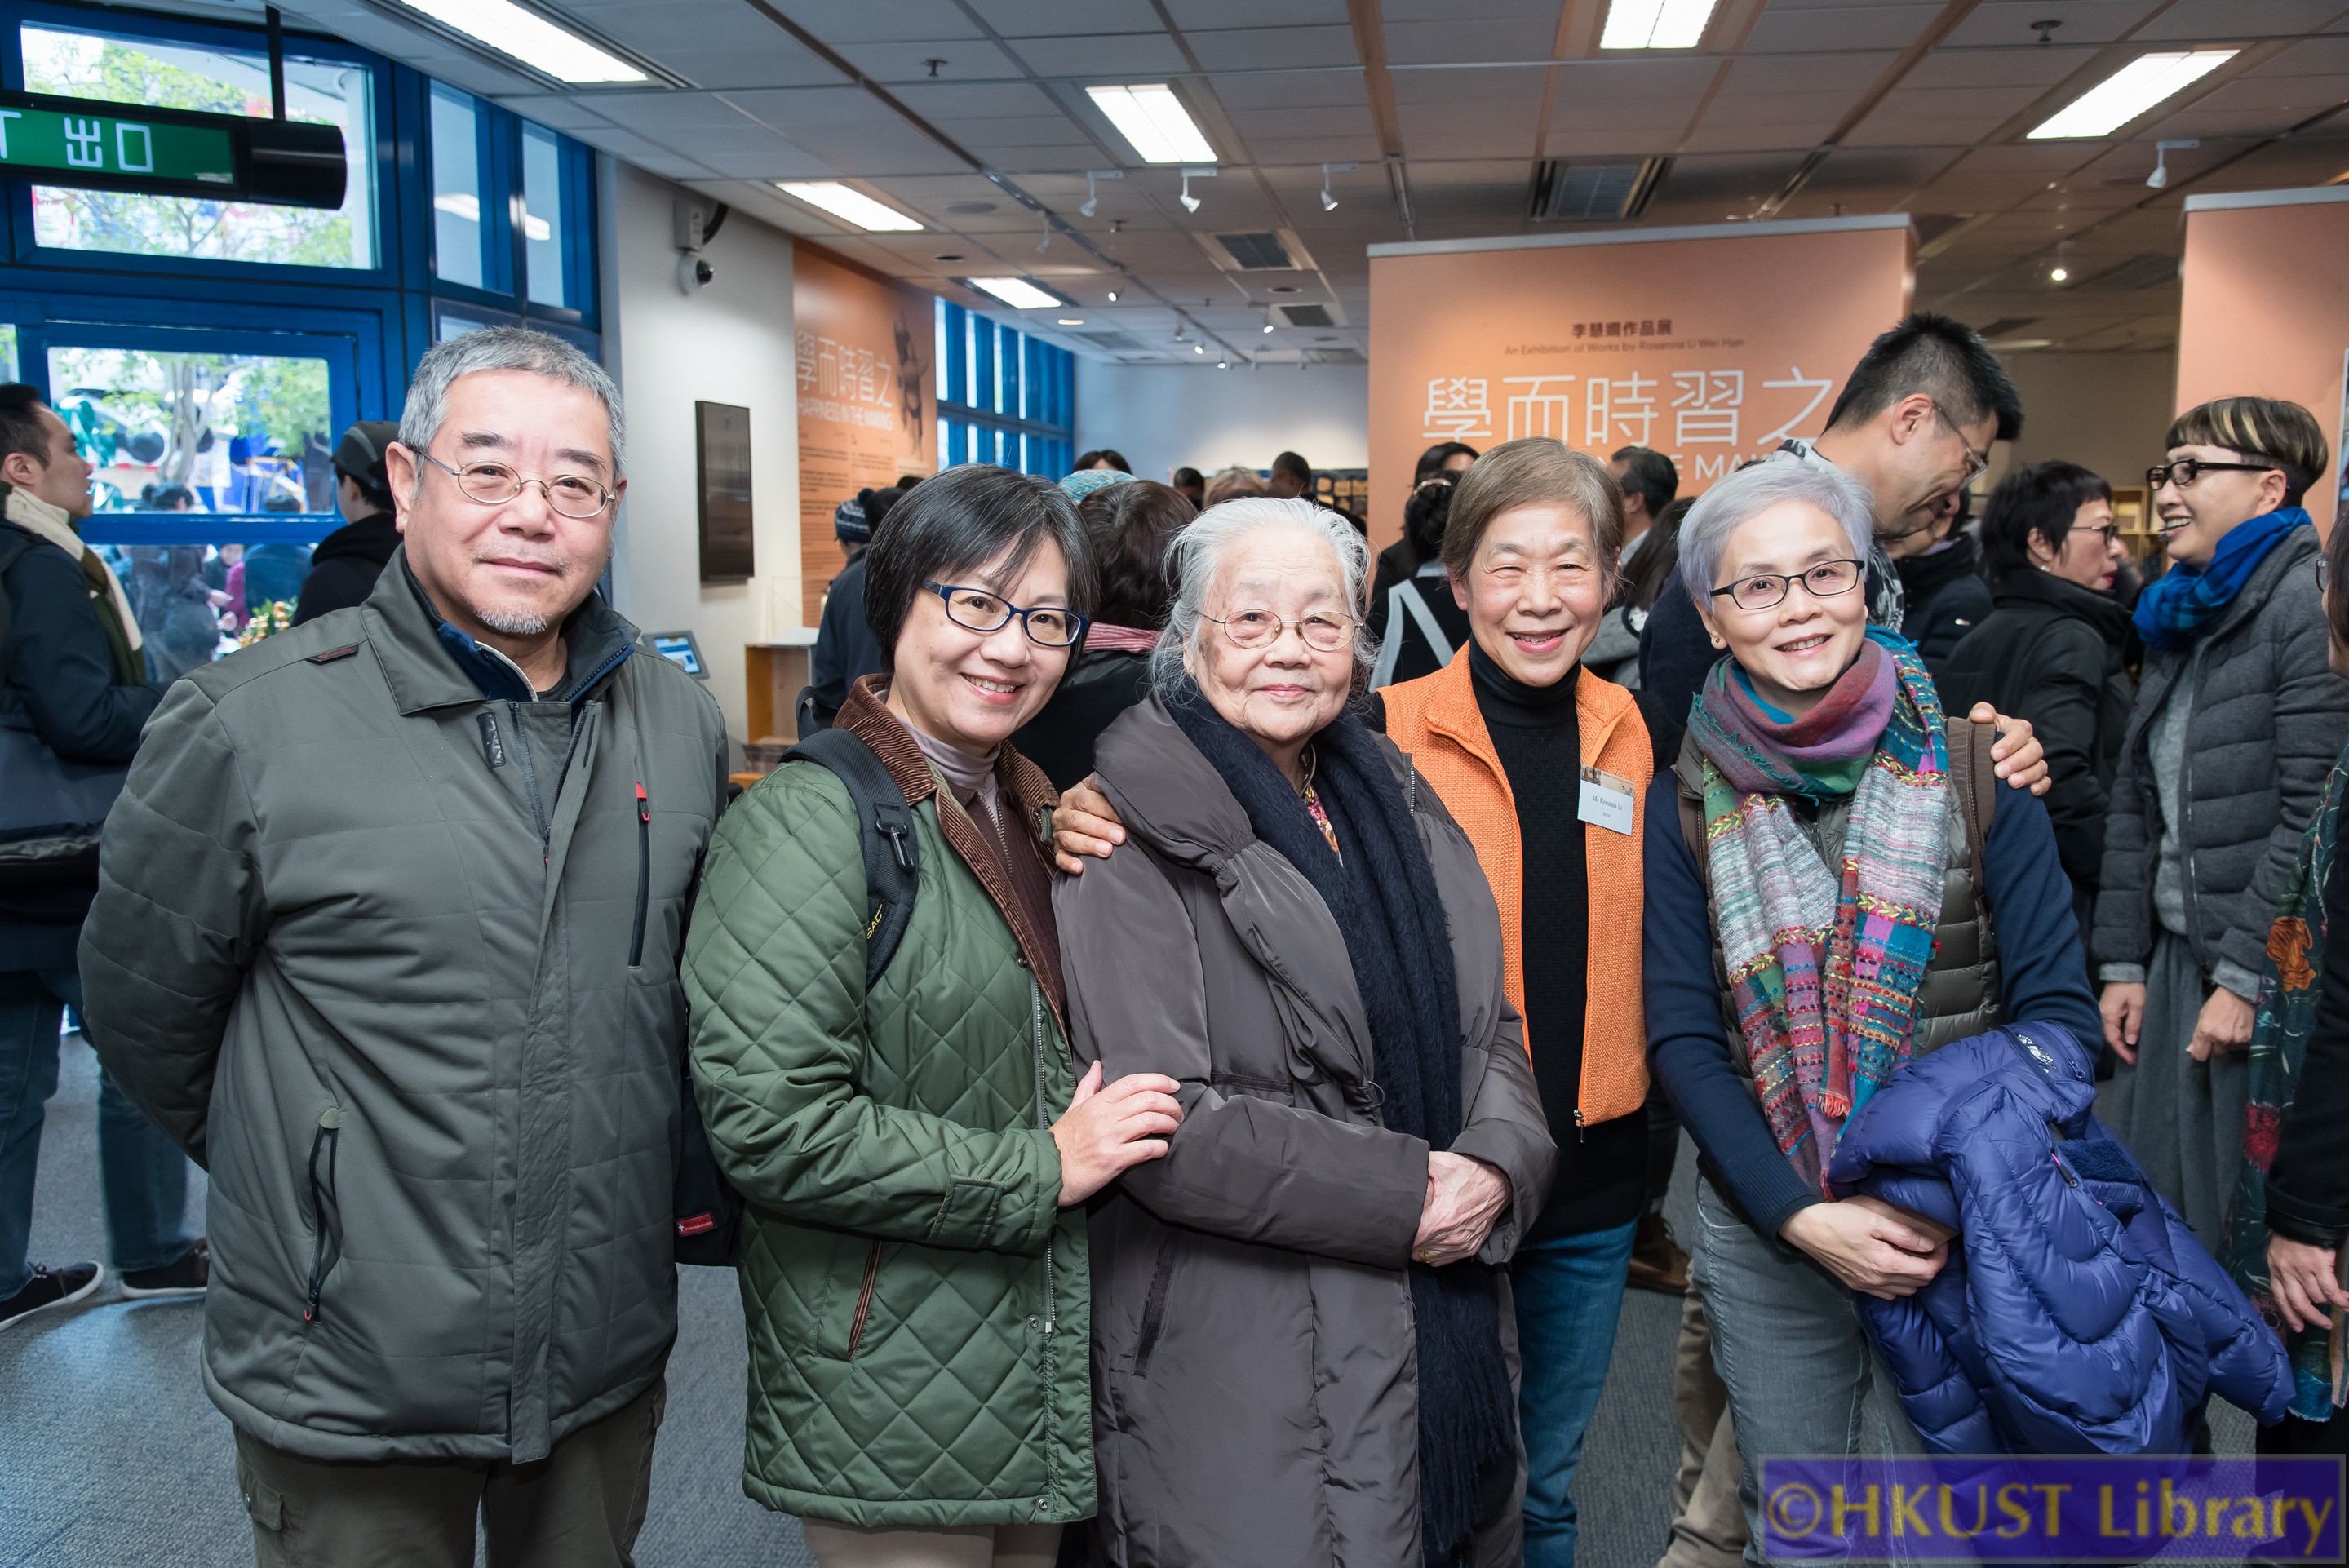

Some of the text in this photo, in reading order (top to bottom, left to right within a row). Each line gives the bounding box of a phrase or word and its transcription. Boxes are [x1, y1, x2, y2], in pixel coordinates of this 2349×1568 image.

[64, 117, 153, 173] 出口
[796, 330, 893, 409] 學而時習之
[1521, 344, 1571, 355] Exhibition
[1573, 343, 1585, 353] of
[1587, 343, 1620, 352] Works
[1622, 342, 1635, 352] by
[1422, 367, 1834, 448] 學而時習之
